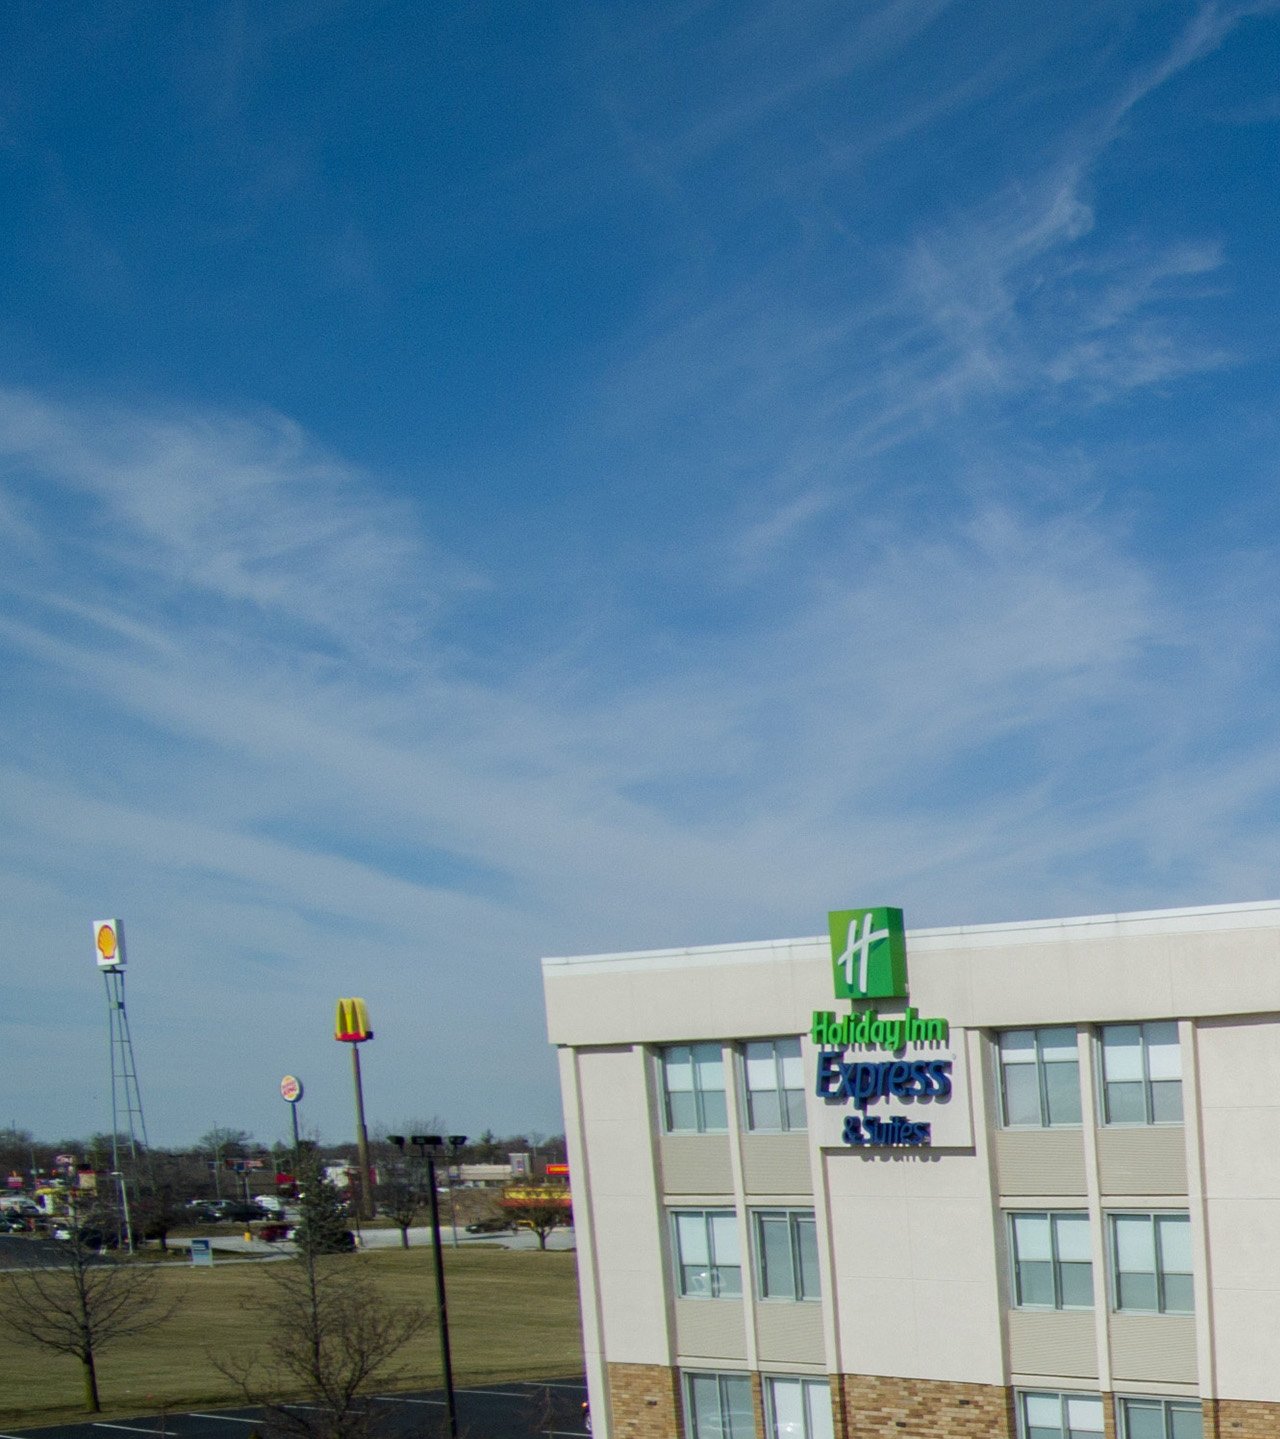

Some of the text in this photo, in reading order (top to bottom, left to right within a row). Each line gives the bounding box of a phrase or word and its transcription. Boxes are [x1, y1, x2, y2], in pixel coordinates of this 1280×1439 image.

[811, 1007, 948, 1051] Holiday Inn
[815, 1051, 953, 1110] Express
[842, 1115, 931, 1145] & Suites
